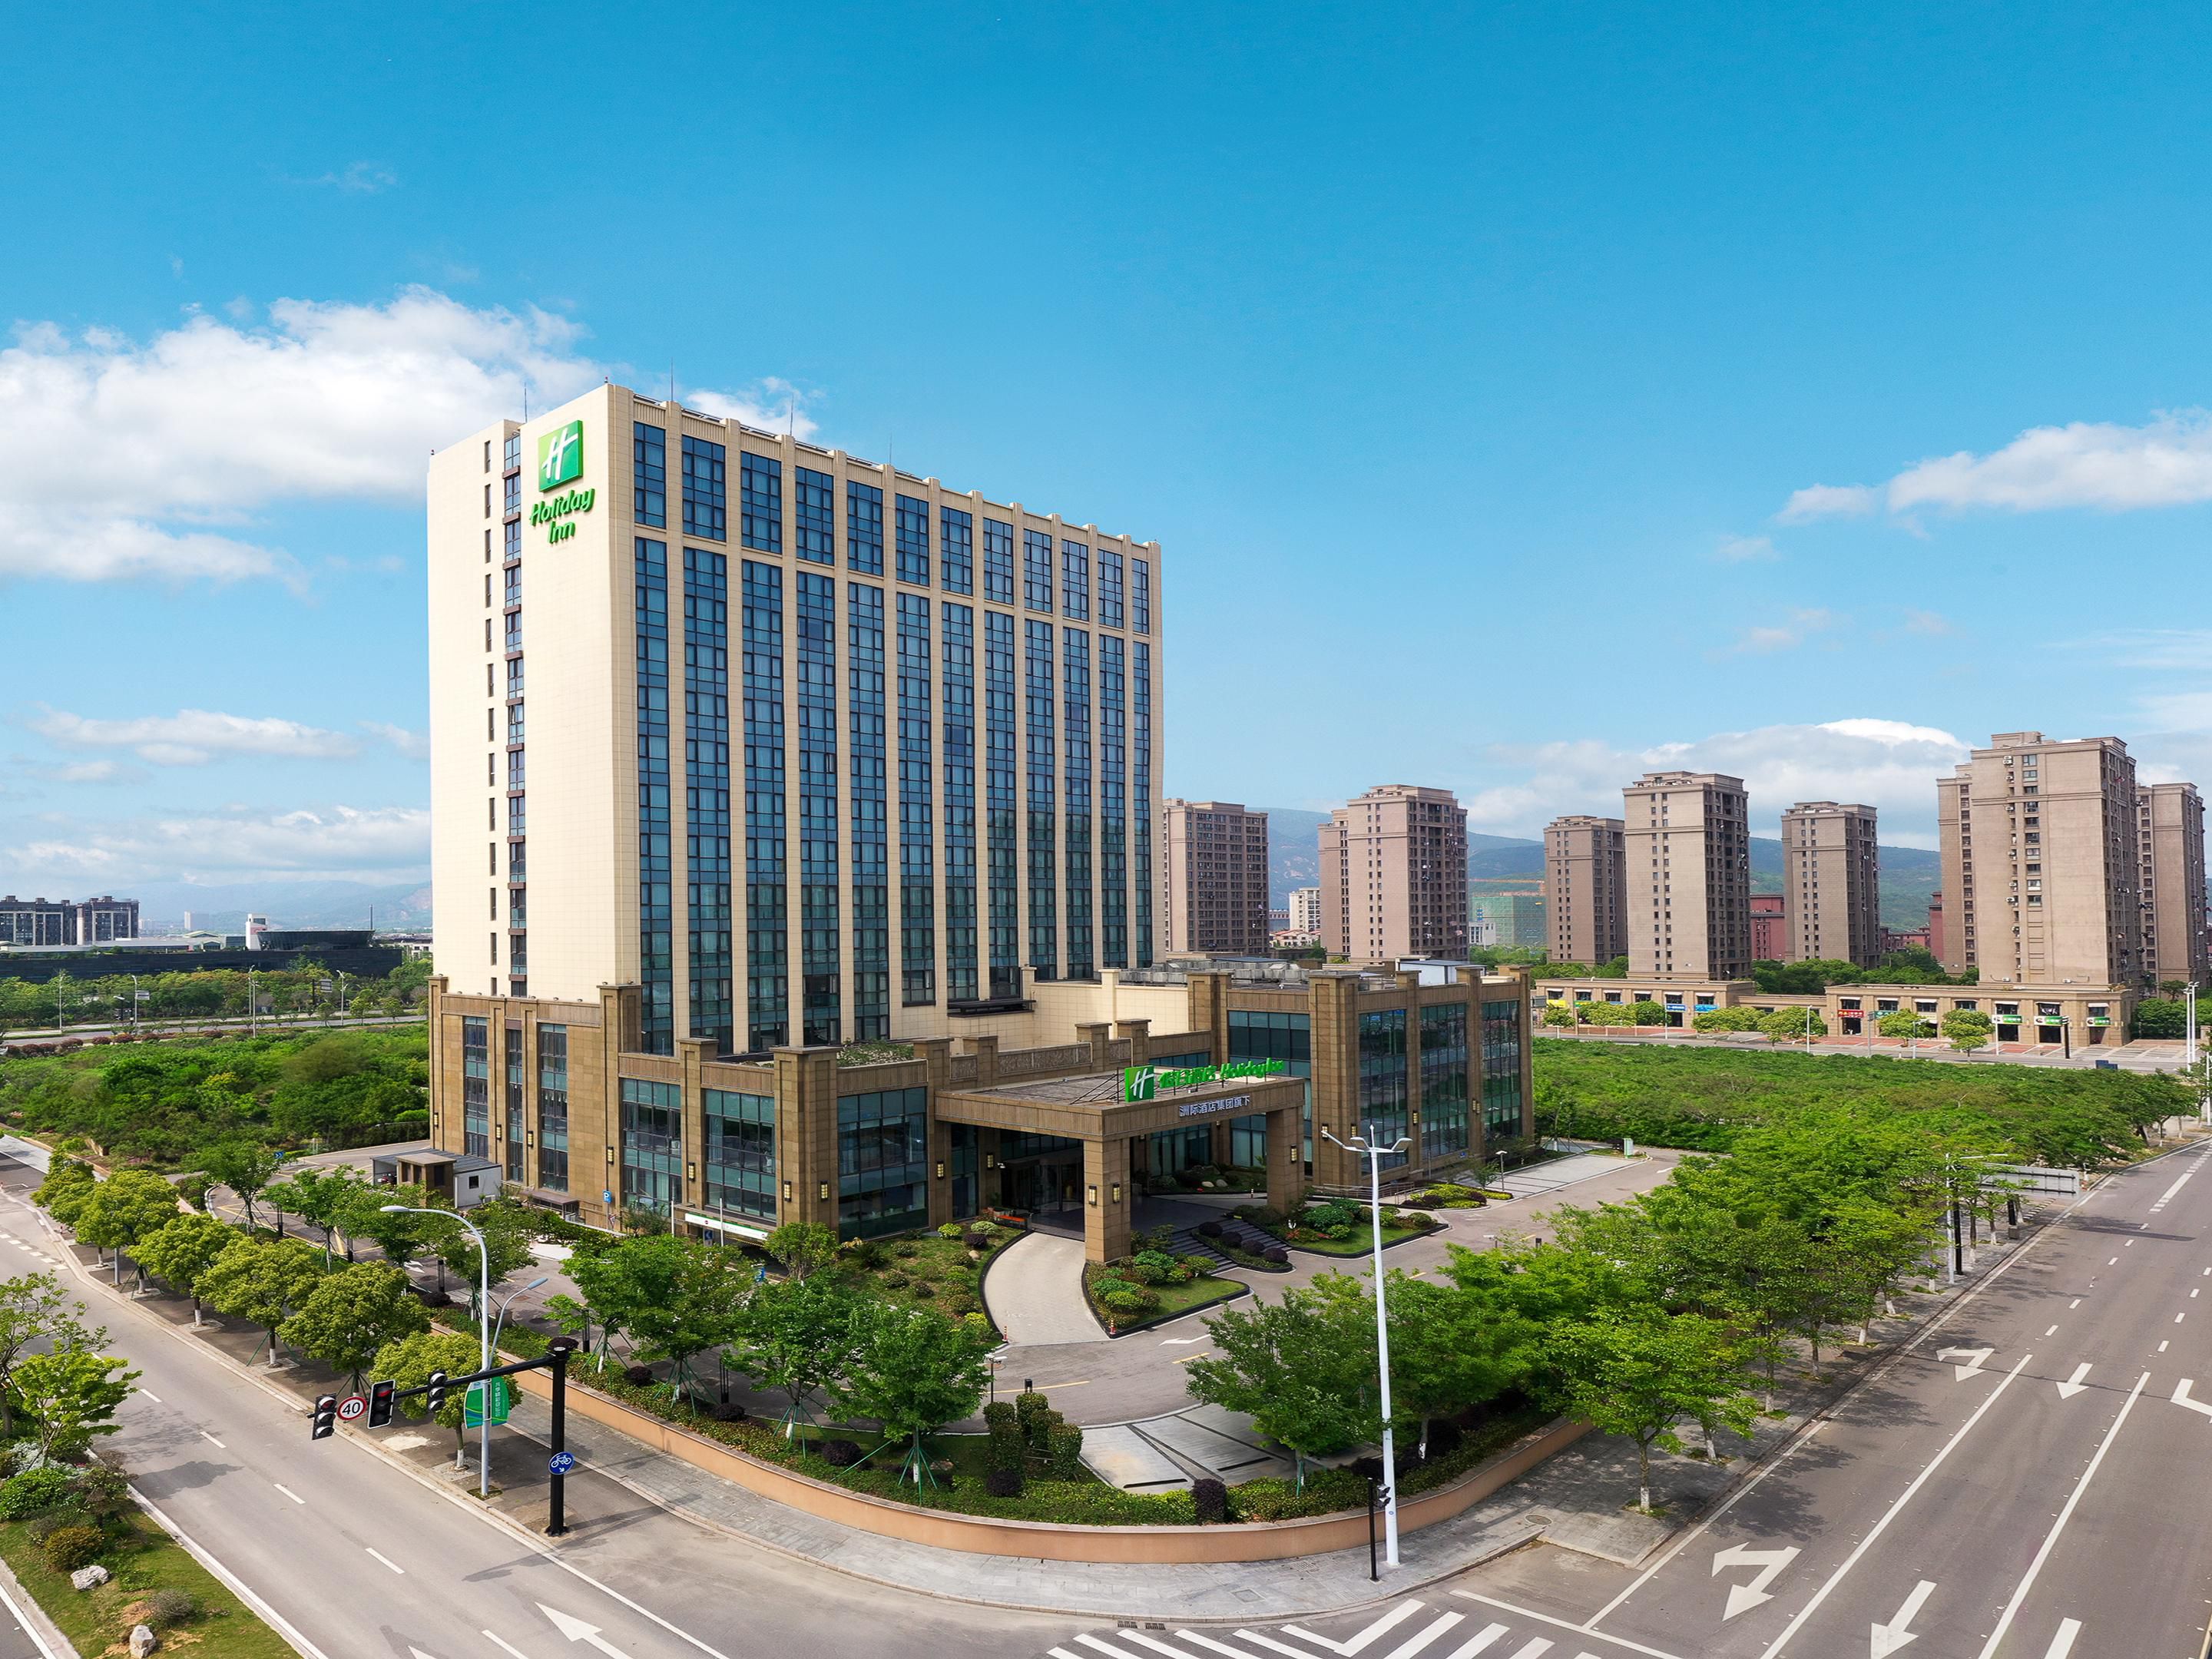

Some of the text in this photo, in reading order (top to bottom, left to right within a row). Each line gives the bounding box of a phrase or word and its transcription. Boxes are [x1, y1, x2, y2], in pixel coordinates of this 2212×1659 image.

[529, 488, 595, 526] Holiday
[548, 520, 576, 544] Inn
[1220, 1057, 1285, 1081] Holiday Inn
[1179, 1095, 1250, 1117] 洲际酒店集团旗下
[342, 1402, 360, 1415] 40
